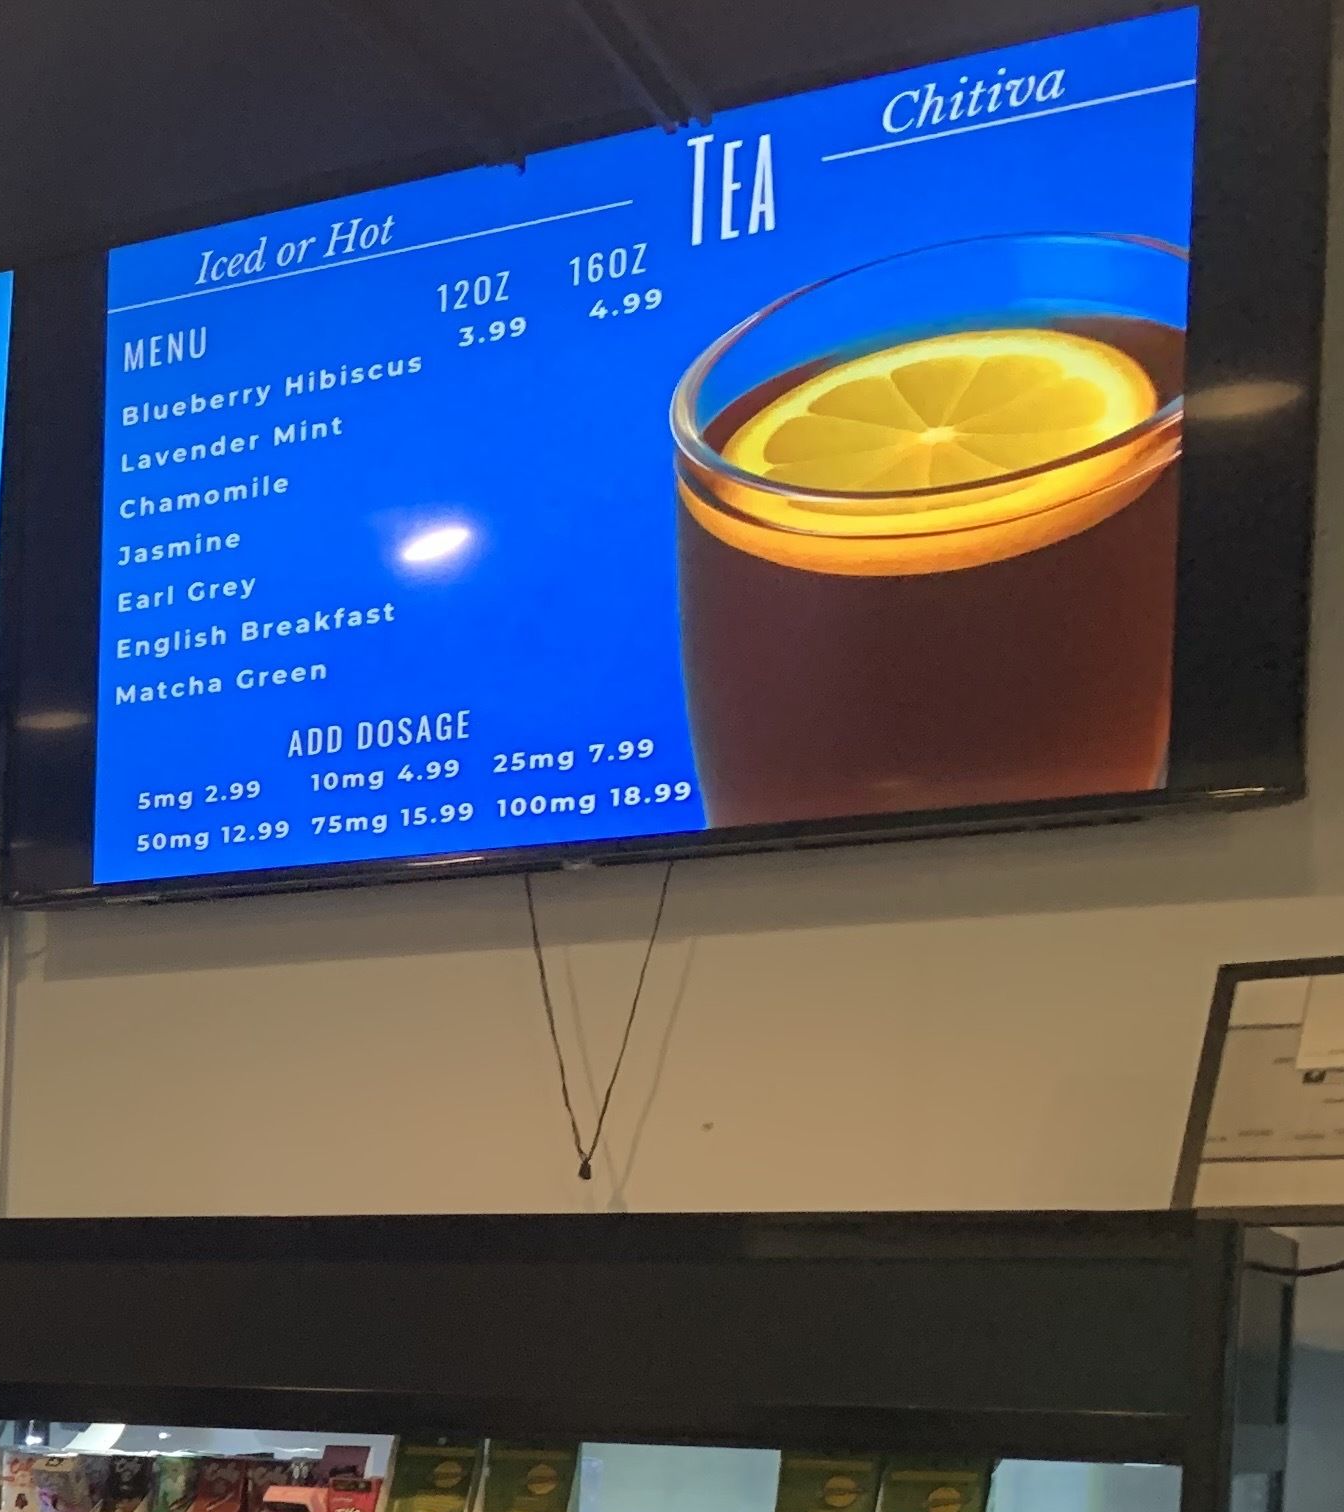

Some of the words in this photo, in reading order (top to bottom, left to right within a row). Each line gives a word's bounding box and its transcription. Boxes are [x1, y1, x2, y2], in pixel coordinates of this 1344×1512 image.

[882, 66, 1067, 135] Chitiva
[687, 133, 776, 246] TEA
[194, 238, 267, 285] Iced
[276, 237, 315, 267] or
[325, 214, 396, 258] Hot
[437, 271, 511, 312] 12OZ
[568, 243, 648, 287] 16OZ
[457, 317, 527, 347] 3.99
[589, 289, 663, 320] 4.99
[123, 327, 207, 372] MENU
[122, 382, 270, 427] Blueberry
[285, 355, 422, 397] Hibiscus
[121, 430, 260, 472] Lavender
[274, 417, 343, 447] Mint
[120, 475, 289, 519] Chamomile
[118, 530, 241, 566] Jasmine
[118, 585, 174, 613] Earl
[188, 575, 257, 604] Grey
[117, 625, 227, 660] English
[241, 602, 396, 642] Breakfast
[116, 674, 222, 705] Matcha
[237, 662, 327, 690] Green
[288, 729, 343, 758] ADD
[357, 710, 471, 752] DOSAGE
[493, 748, 574, 774] 25mg
[588, 738, 655, 765] 7.99
[138, 788, 192, 811] 5mg
[205, 780, 261, 805] 2.99
[311, 768, 384, 793] 10mg
[397, 760, 460, 784] 4.99
[311, 811, 389, 837] 75mg
[400, 803, 474, 829] 15.99
[497, 792, 596, 819] 100mg
[609, 782, 691, 809] 18.99
[136, 830, 210, 854] 50mg
[221, 821, 290, 845] 12.99
